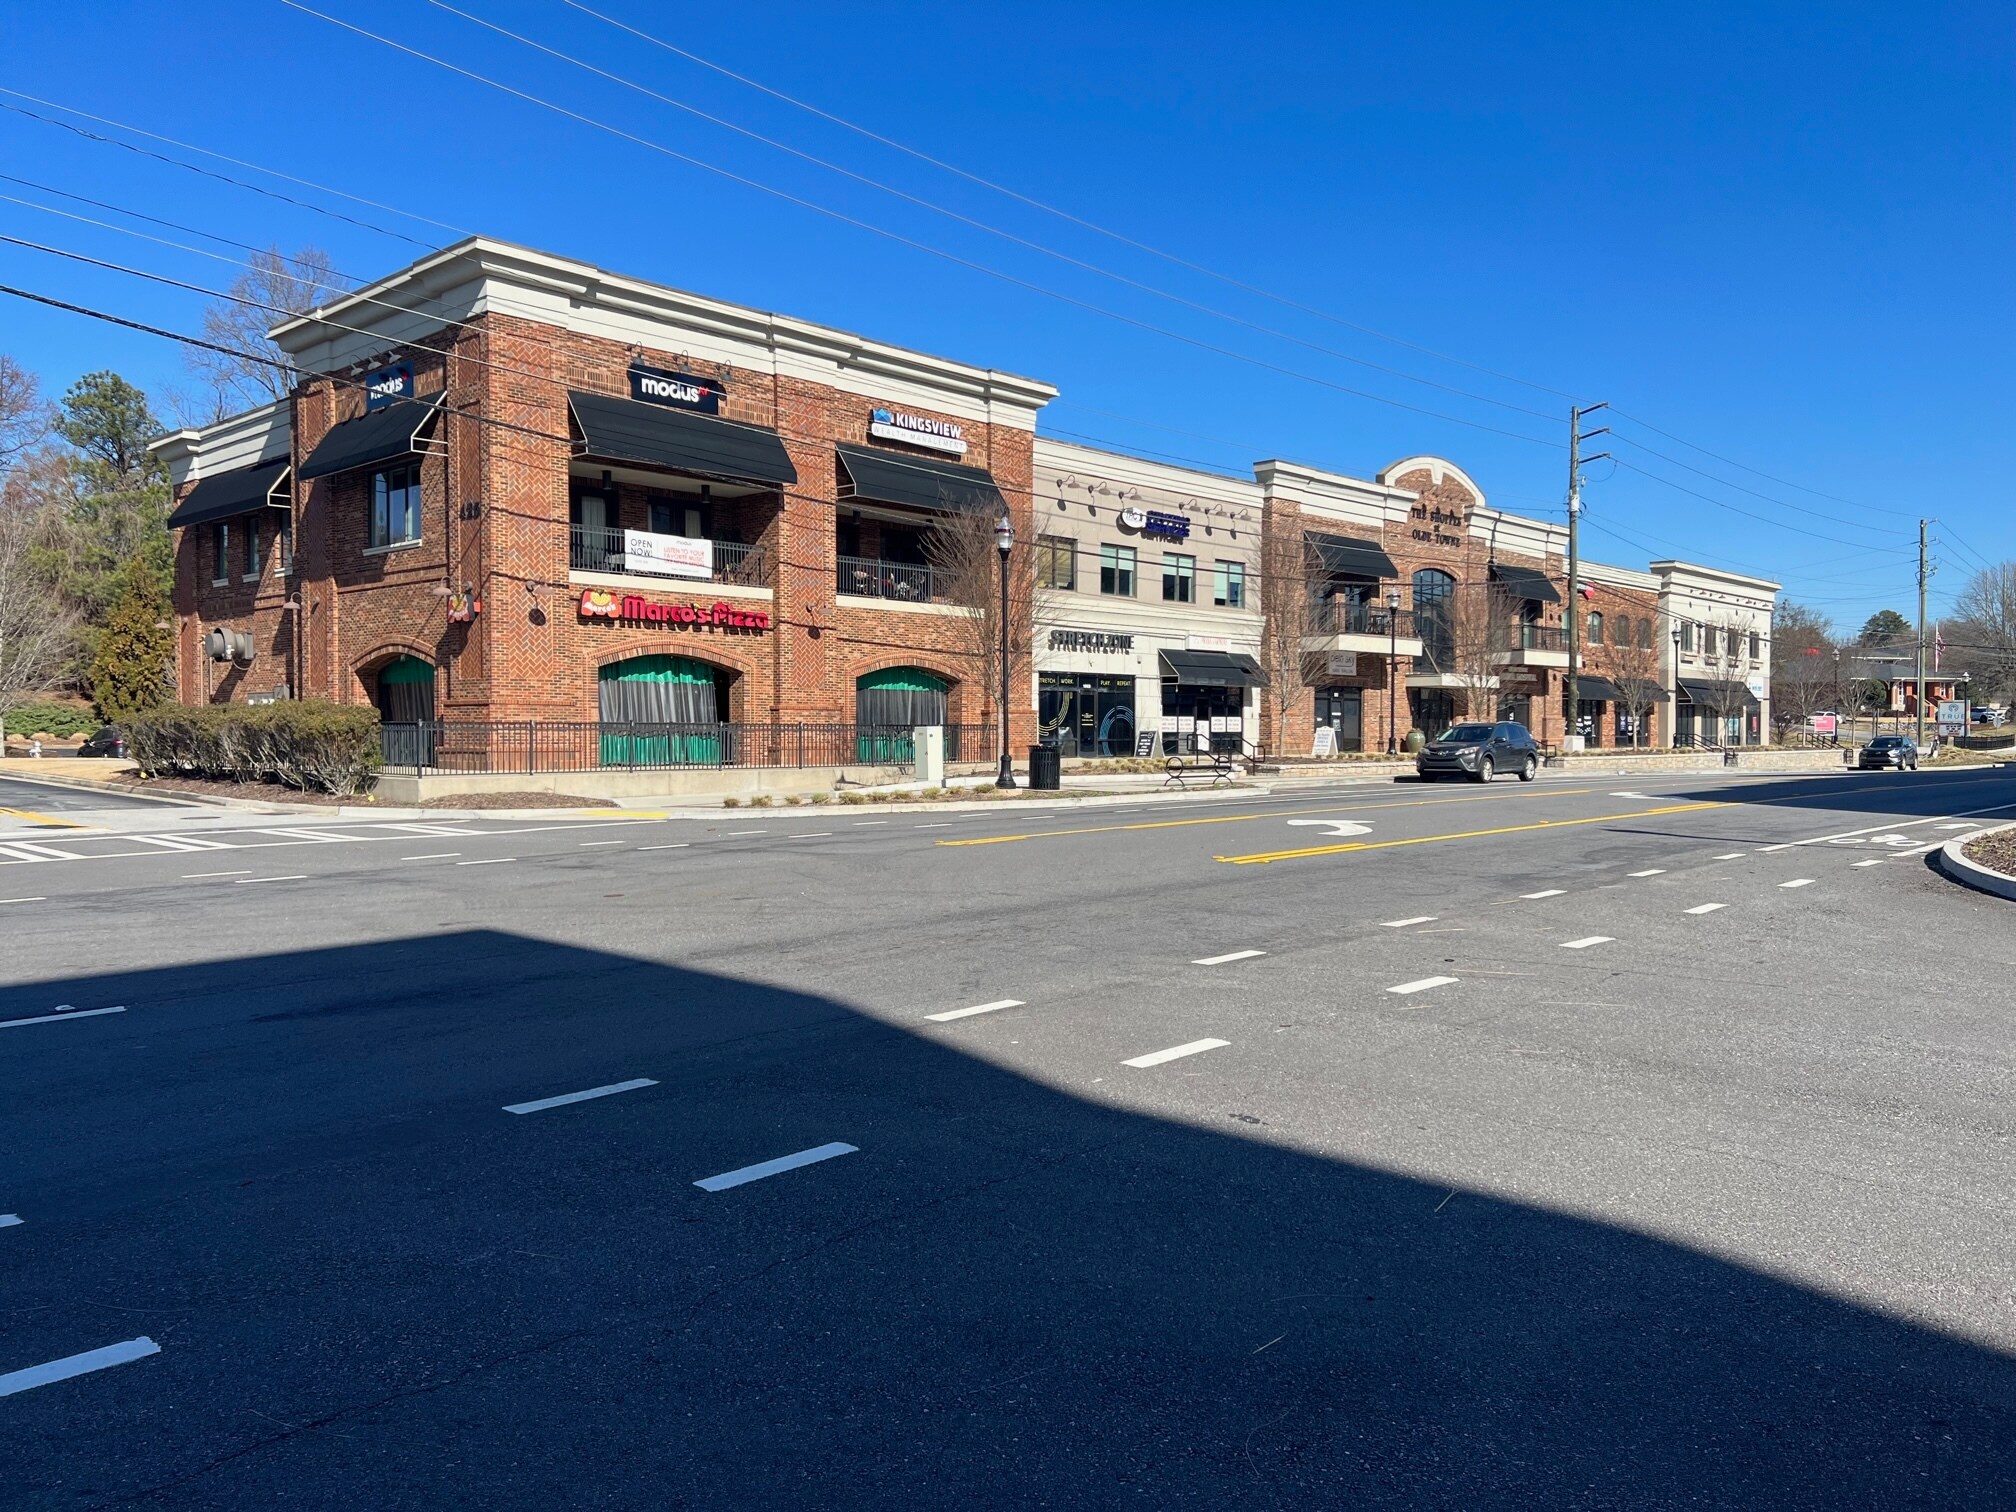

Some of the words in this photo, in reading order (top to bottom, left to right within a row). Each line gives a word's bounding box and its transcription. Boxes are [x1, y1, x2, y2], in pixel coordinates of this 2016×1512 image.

[641, 378, 699, 403] modus
[896, 412, 961, 439] KINGSVIEW
[873, 426, 906, 438] WEALTH
[910, 433, 964, 450] MANAGEMENT
[1411, 507, 1426, 520] THE
[1430, 510, 1461, 526] SHOPPES
[631, 539, 653, 549] OPEN
[1412, 529, 1431, 542] OLDE
[1435, 533, 1461, 547] TOWNE
[631, 548, 653, 557] NOW!
[622, 596, 706, 624] Marco's
[711, 602, 769, 629] Pizza
[1051, 630, 1104, 648] STRETCH
[1105, 633, 1134, 649] ZONE
